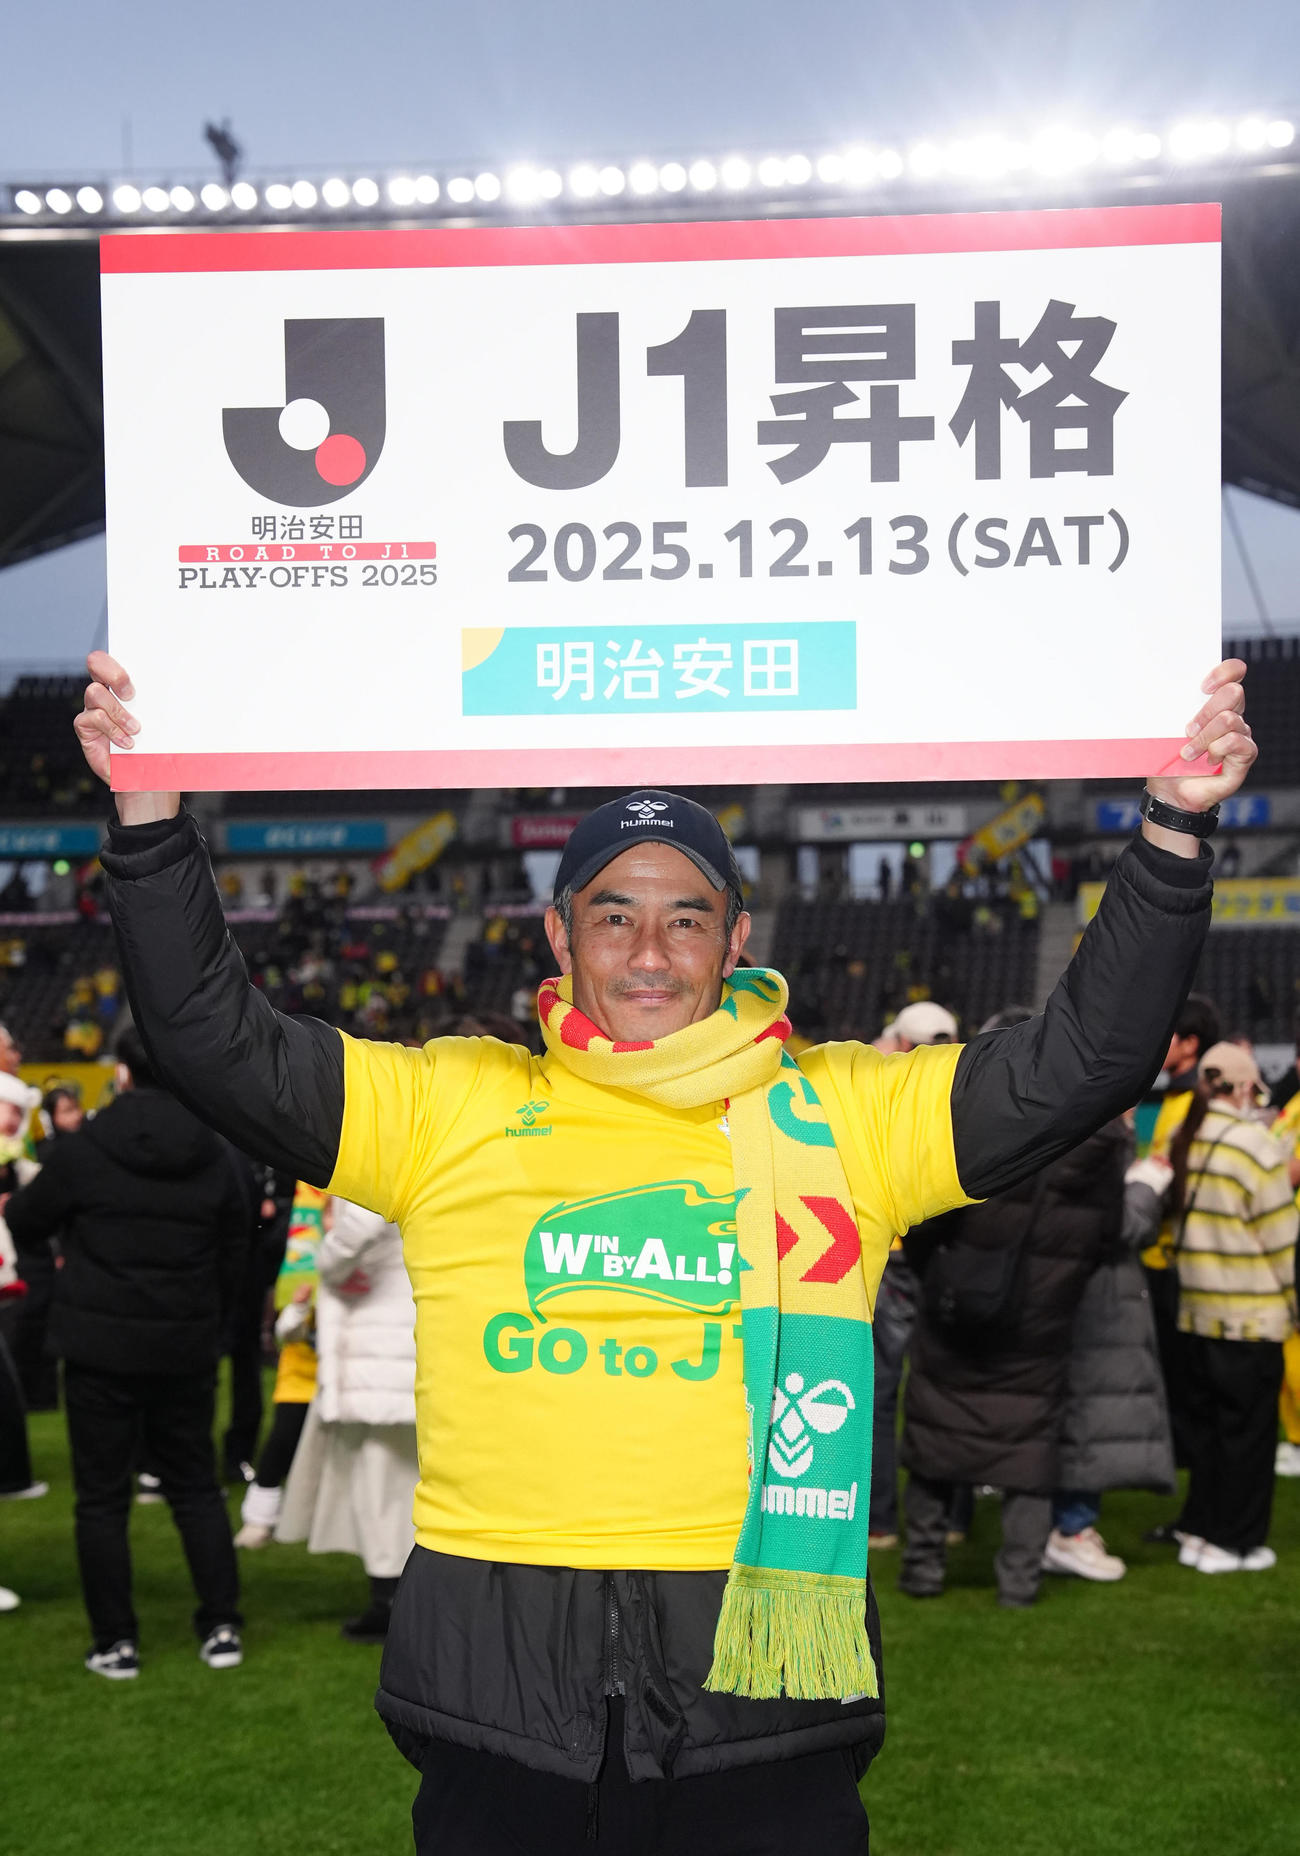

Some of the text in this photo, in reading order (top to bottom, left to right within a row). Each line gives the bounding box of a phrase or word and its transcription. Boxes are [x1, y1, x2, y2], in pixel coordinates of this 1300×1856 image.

[502, 298, 1130, 491] J1昇格
[250, 514, 363, 540] 明治安田
[206, 544, 409, 561] ROAD TO J1
[178, 564, 438, 589] PLAY-OFFS 2025
[535, 636, 800, 702] 明治安田
[620, 818, 674, 829] hummel
[504, 1124, 553, 1138] hummel
[631, 1237, 736, 1285] ALL!
[599, 1337, 659, 1378] to
[761, 1482, 858, 1521] mmel
